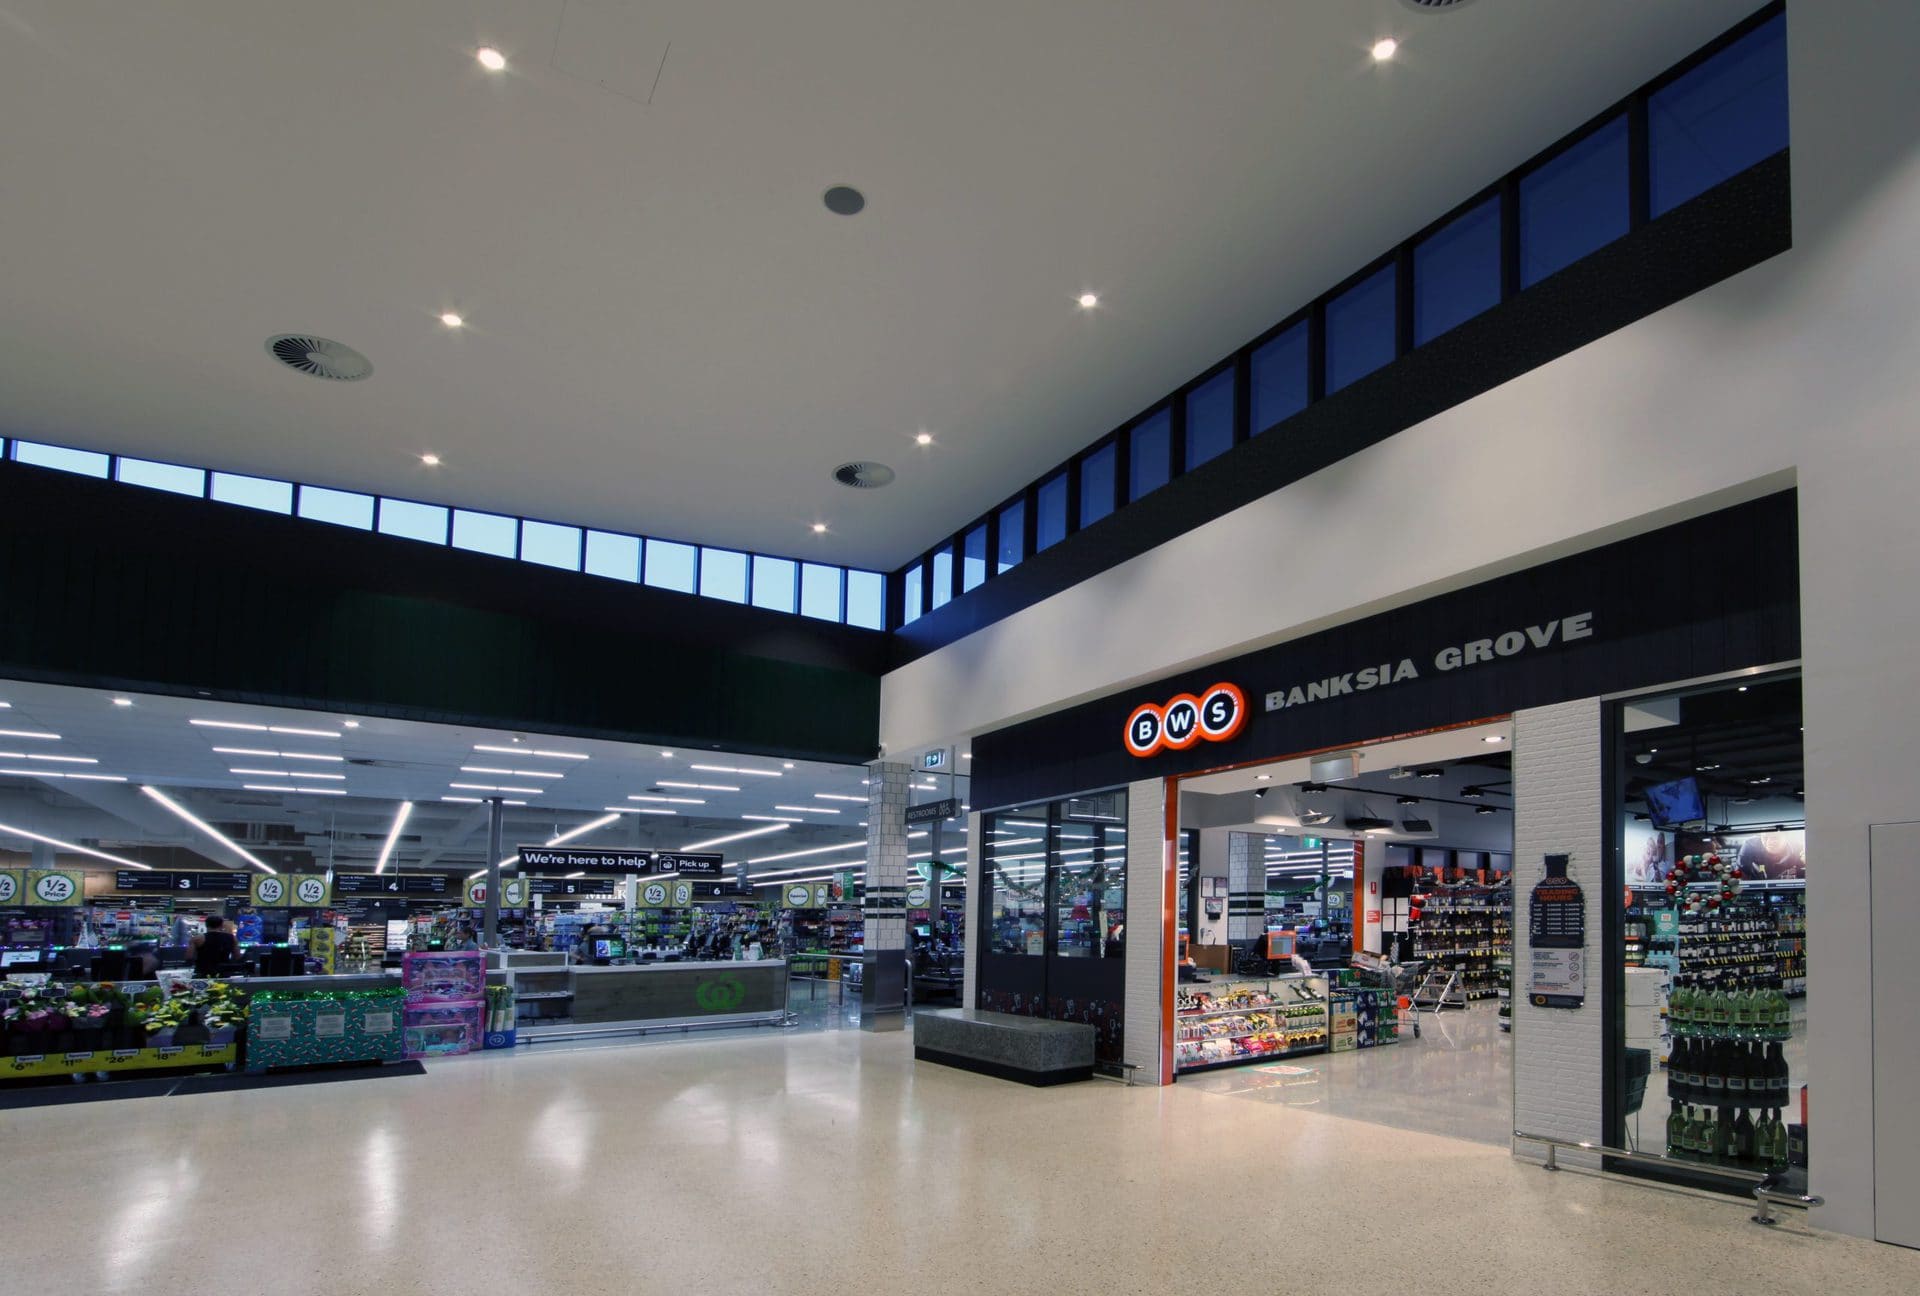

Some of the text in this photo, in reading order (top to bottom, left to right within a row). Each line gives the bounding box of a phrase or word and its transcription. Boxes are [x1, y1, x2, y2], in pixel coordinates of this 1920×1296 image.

[1265, 611, 1593, 712] BANKSIA GROVE
[524, 853, 647, 868] We're here to help
[679, 859, 710, 869] Pick up
[46, 879, 67, 892] 1/2
[179, 879, 191, 889] 3
[263, 882, 278, 894] 1/2
[304, 882, 320, 894] 1/2
[388, 882, 398, 891] 4
[567, 885, 575, 893] 5
[649, 888, 662, 898] 1/2
[713, 887, 721, 895] 6
